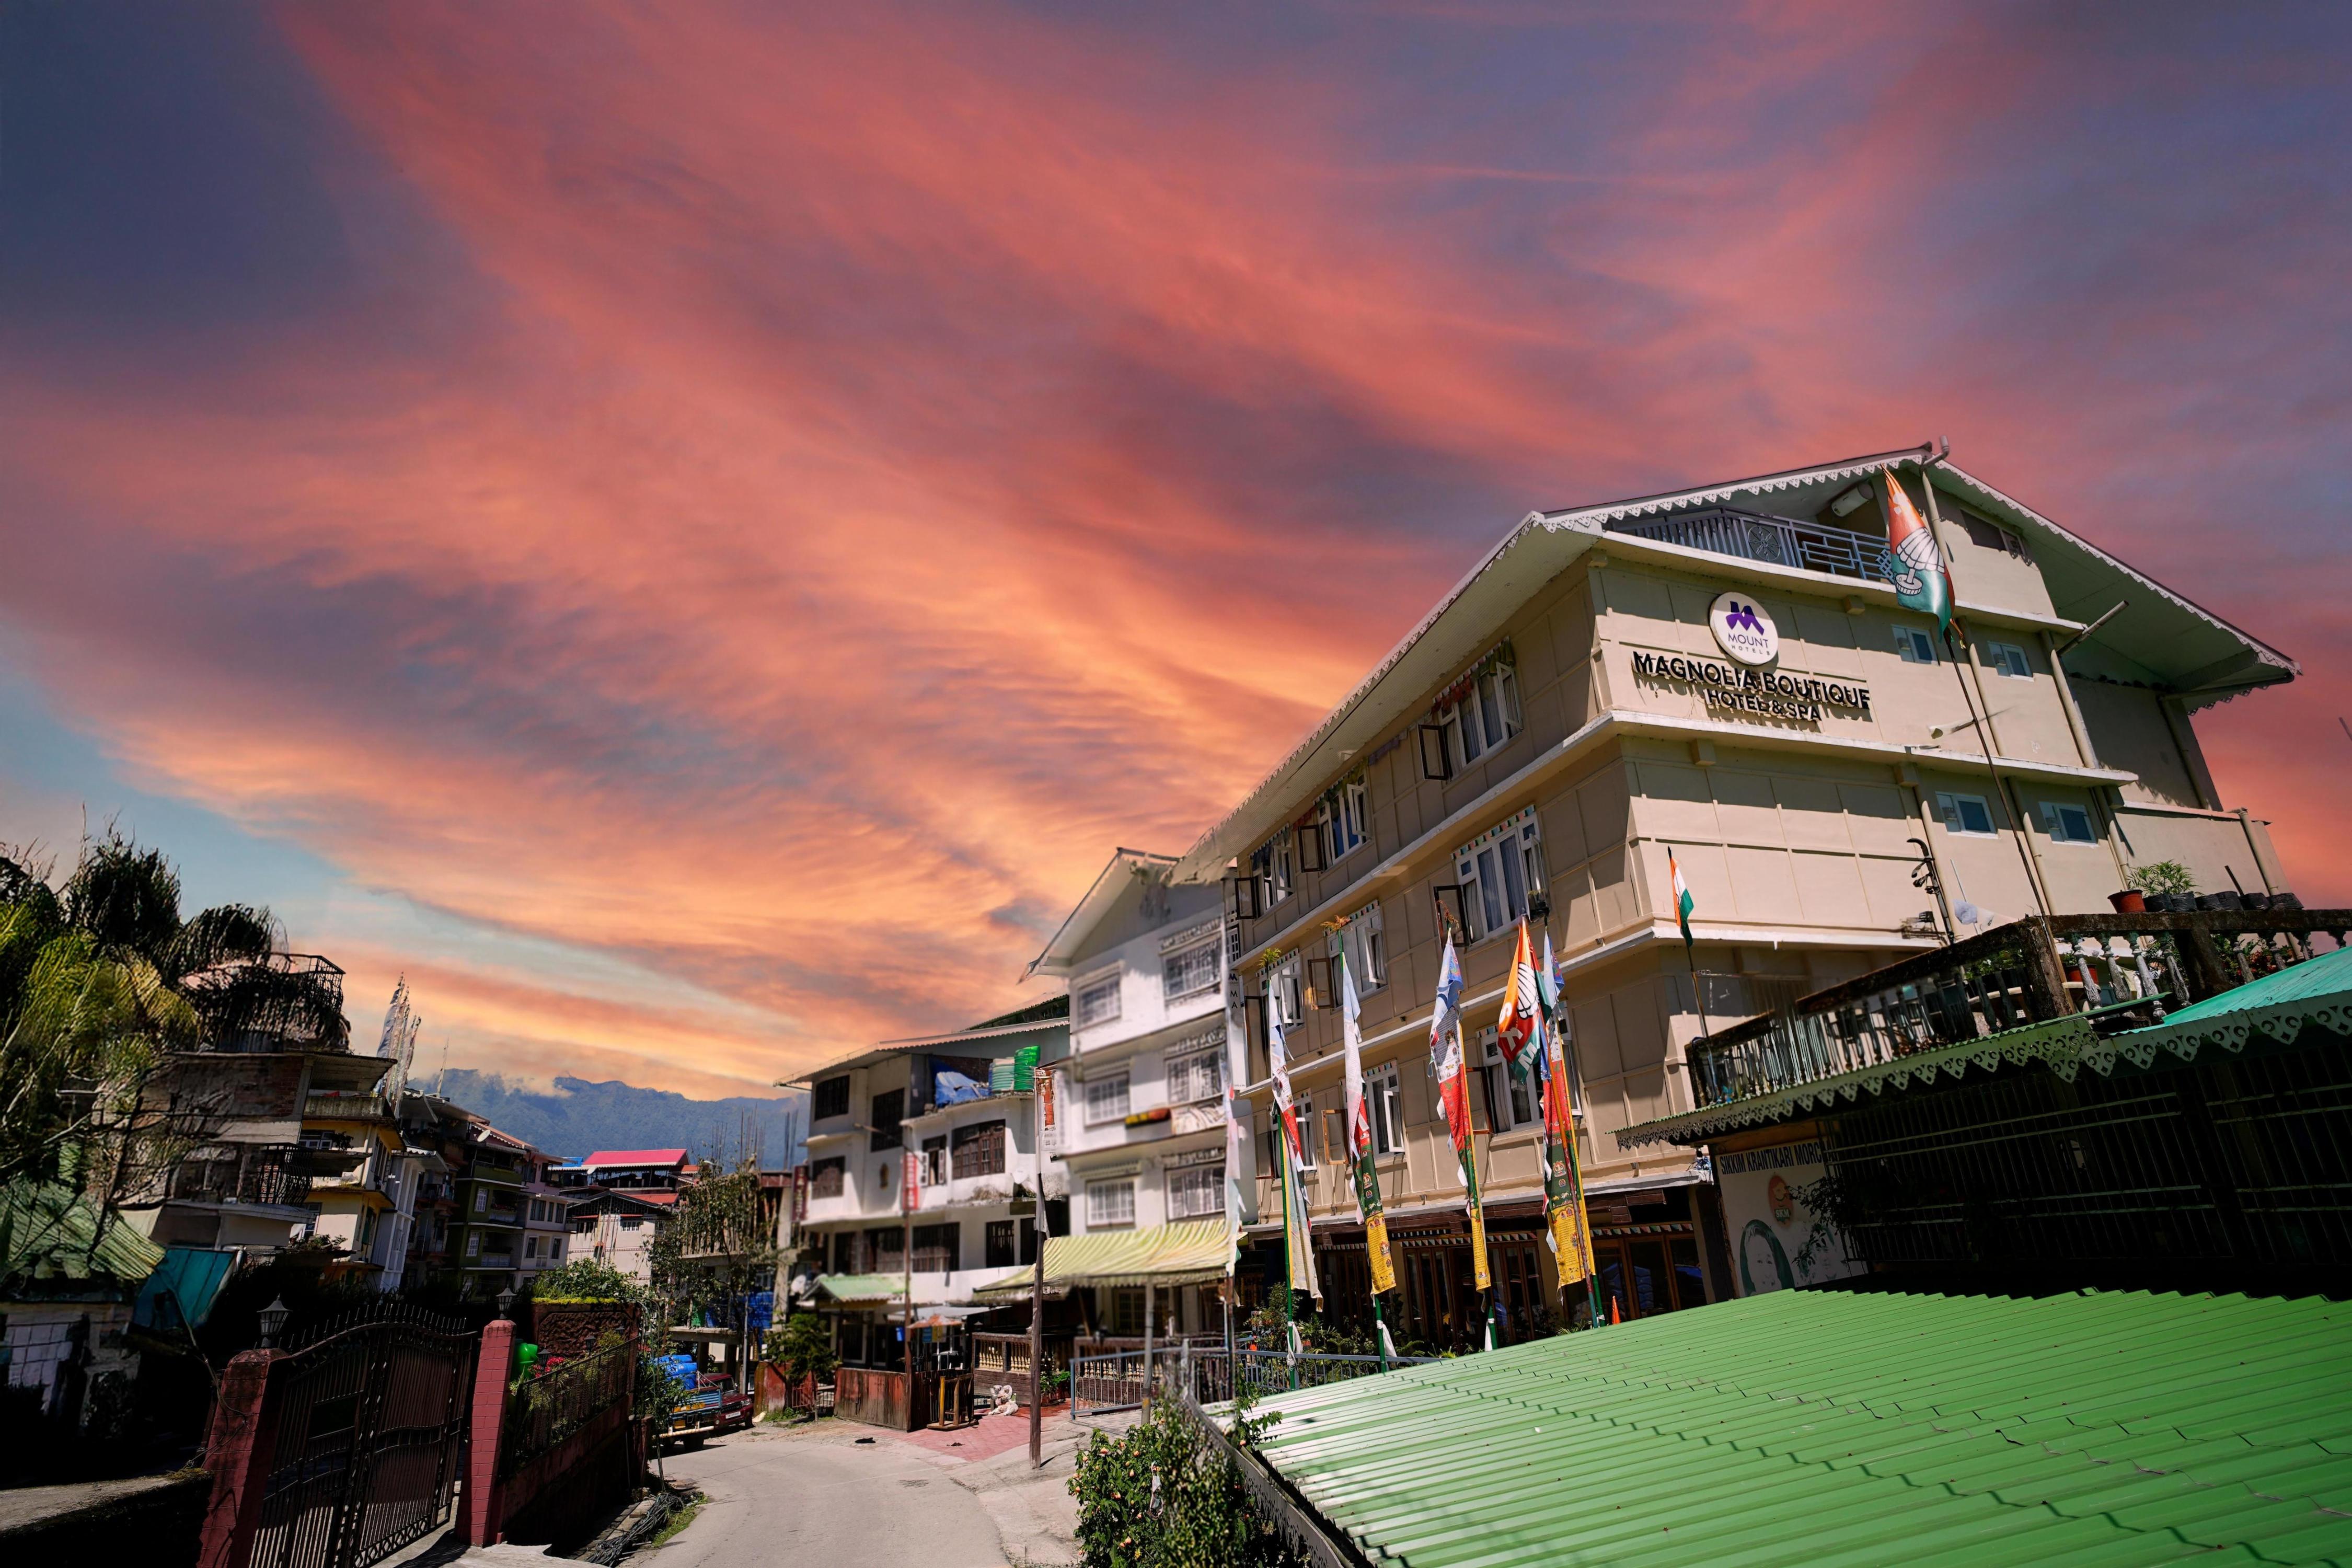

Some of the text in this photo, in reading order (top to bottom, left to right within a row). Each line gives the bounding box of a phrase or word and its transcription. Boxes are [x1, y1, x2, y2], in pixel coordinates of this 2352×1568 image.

[1728, 632, 1768, 649] MOUNT
[1731, 644, 1770, 656] HOTELS
[1631, 651, 1870, 710] MAGNOLIA BOUTIQUE
[1704, 688, 1822, 721] HOTEL & SPA
[1720, 1153, 1747, 1175] SIKKIM
[1746, 1145, 1794, 1172] KRANTIKARI
[1775, 1208, 1790, 1218] SKM
